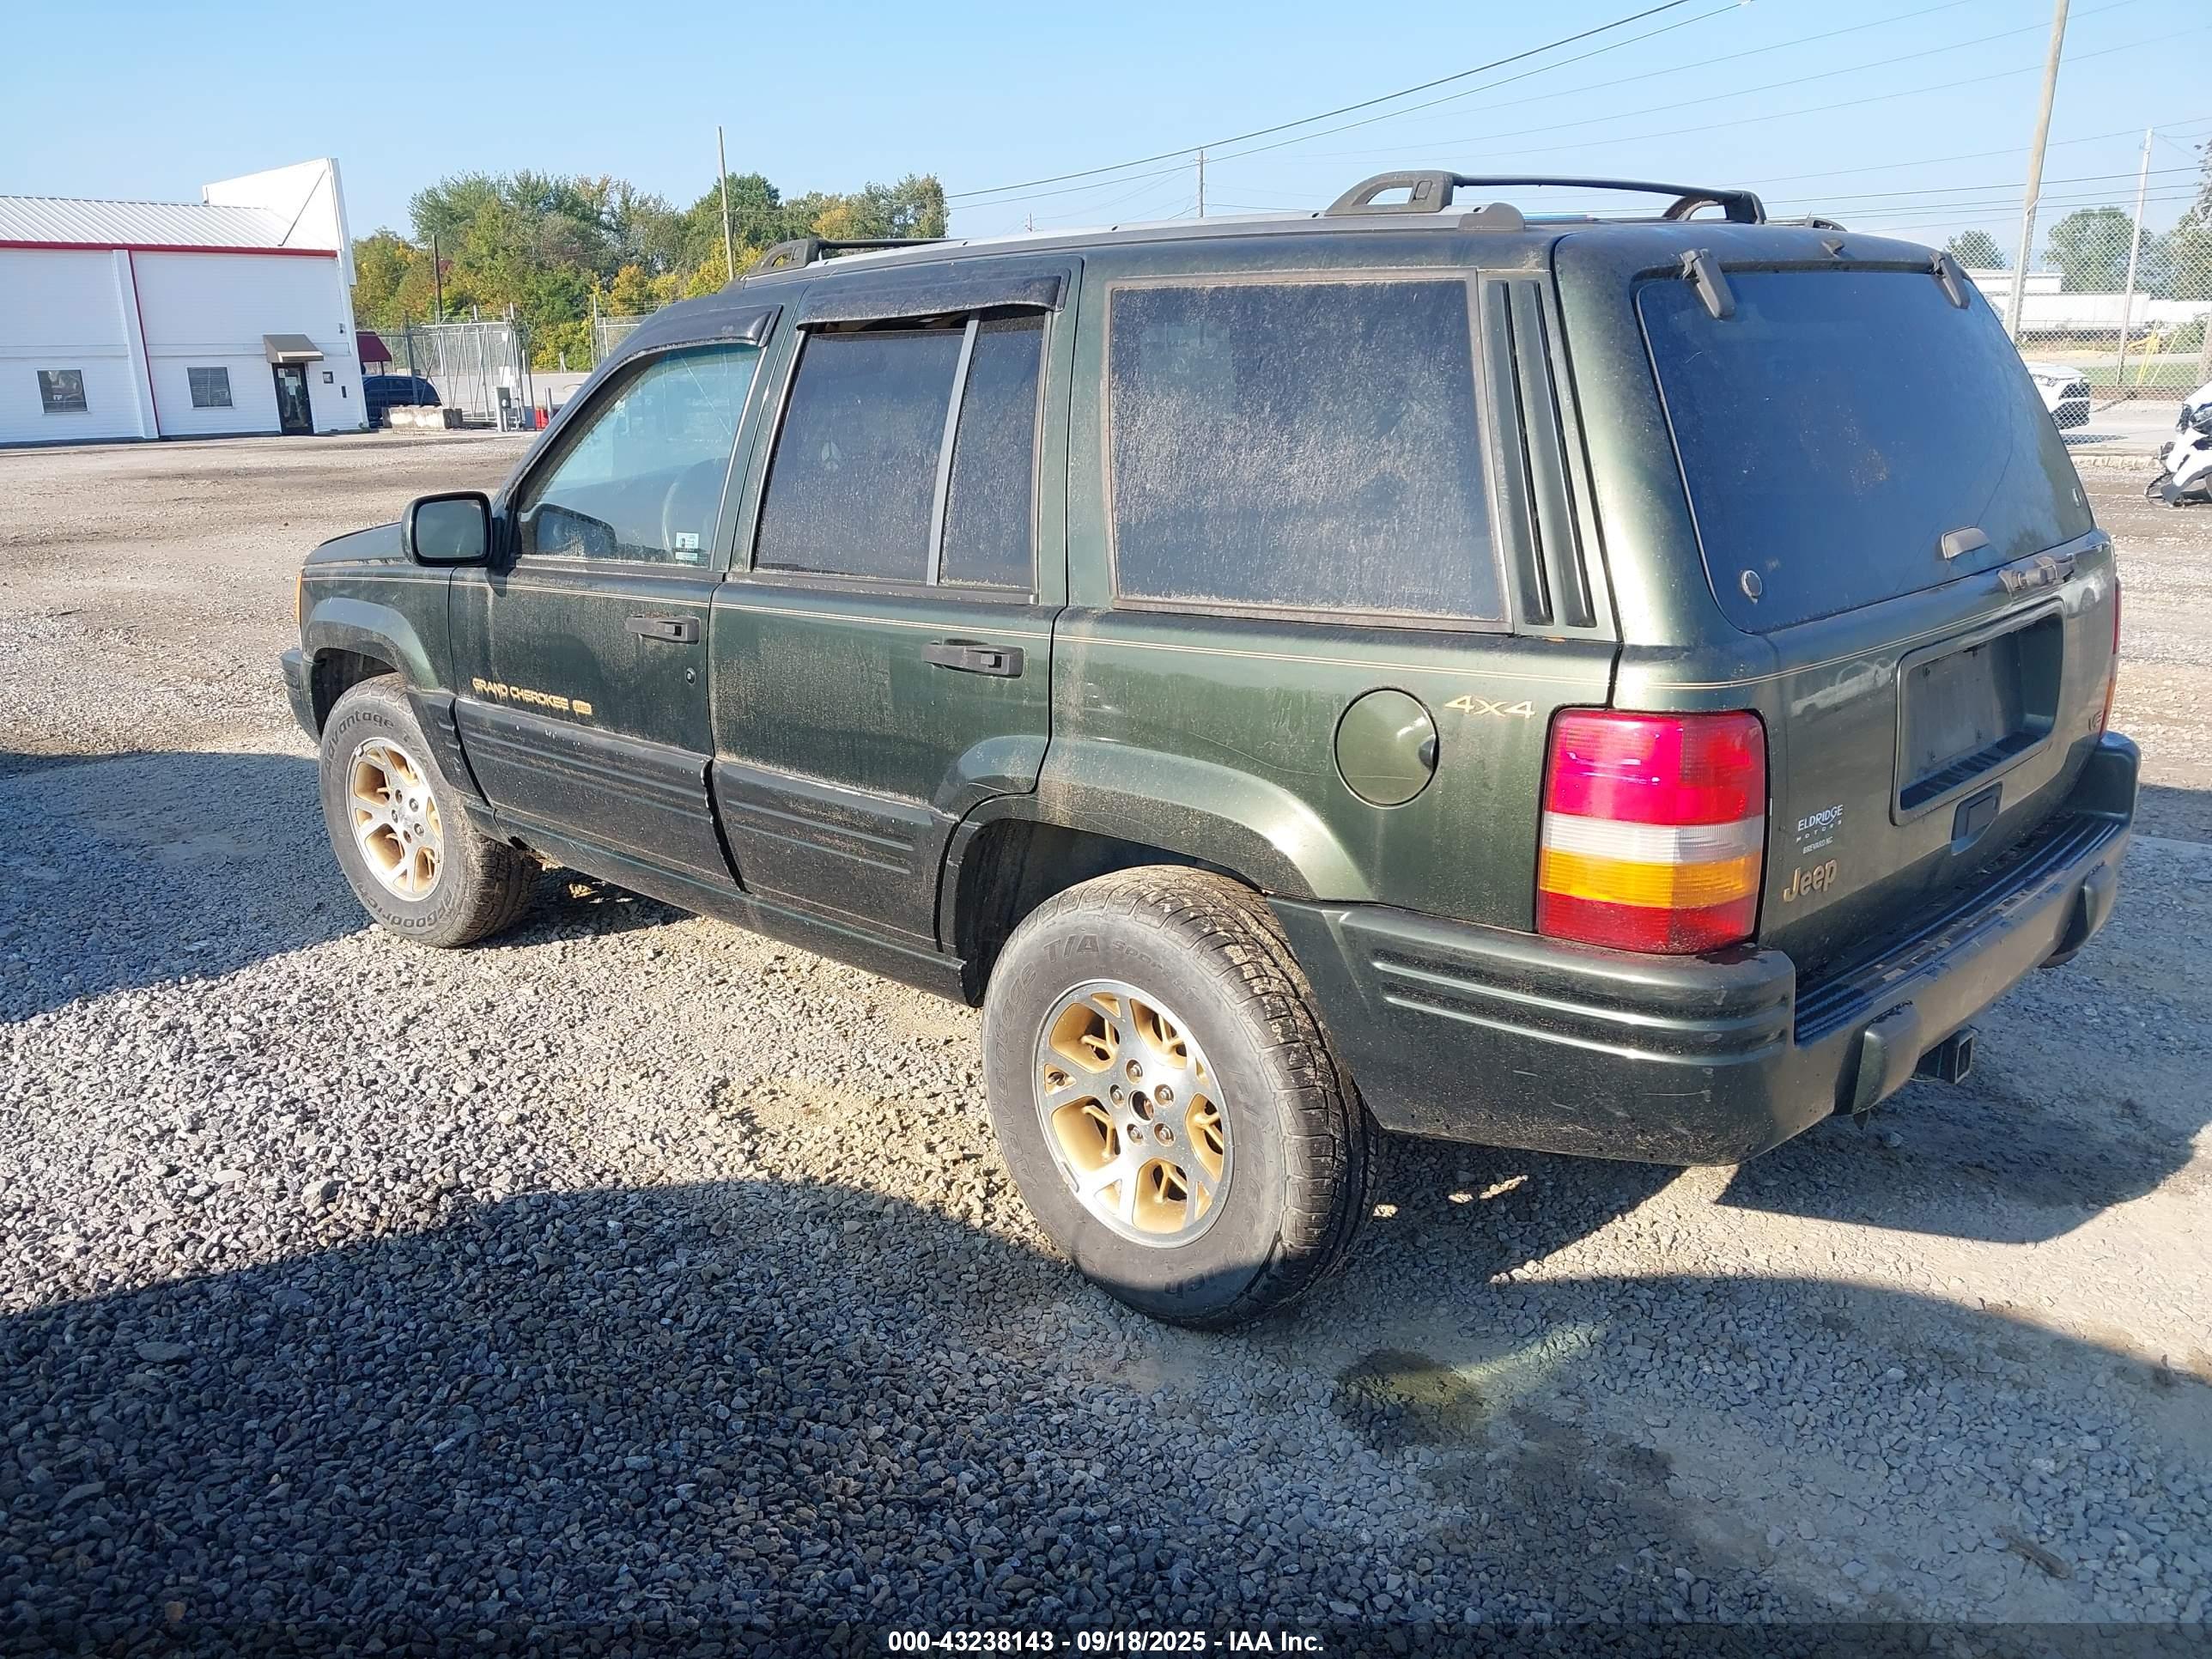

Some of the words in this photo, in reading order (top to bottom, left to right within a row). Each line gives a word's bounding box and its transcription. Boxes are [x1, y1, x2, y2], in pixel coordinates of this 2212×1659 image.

[472, 677, 508, 697] GRAND
[509, 686, 568, 711] CHEROKEE
[1796, 819, 1842, 843] MOTORS
[1797, 804, 1844, 831] ELDRIDGE
[1784, 859, 1838, 902] Jeep
[1043, 933, 1101, 963] T/A
